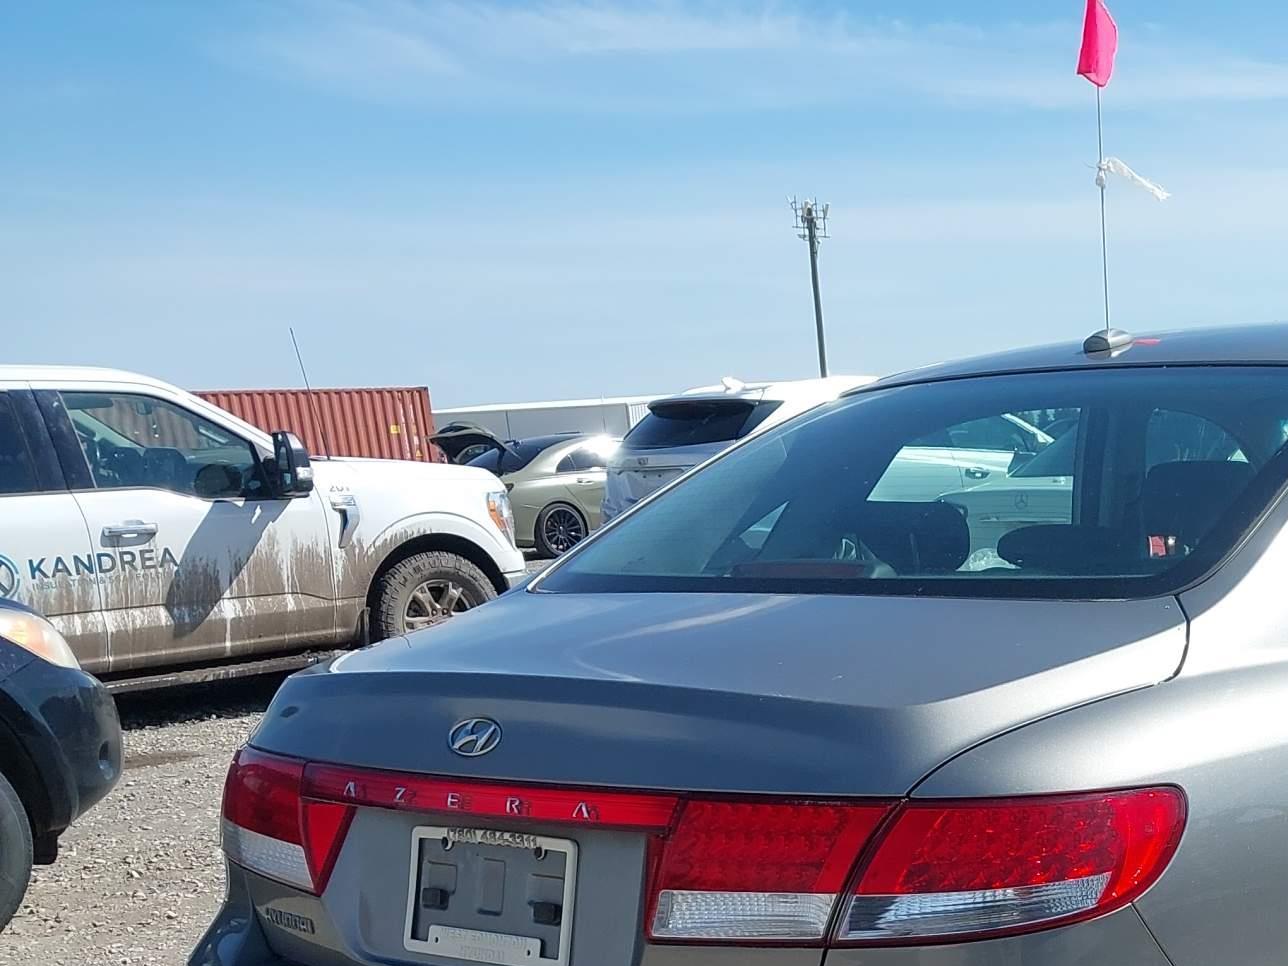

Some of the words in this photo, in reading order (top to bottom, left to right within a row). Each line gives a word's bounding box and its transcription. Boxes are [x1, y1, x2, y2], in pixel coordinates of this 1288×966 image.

[28, 547, 180, 580] KANDREA
[343, 781, 592, 819] AZERA
[265, 907, 316, 935] HYUNDAI
